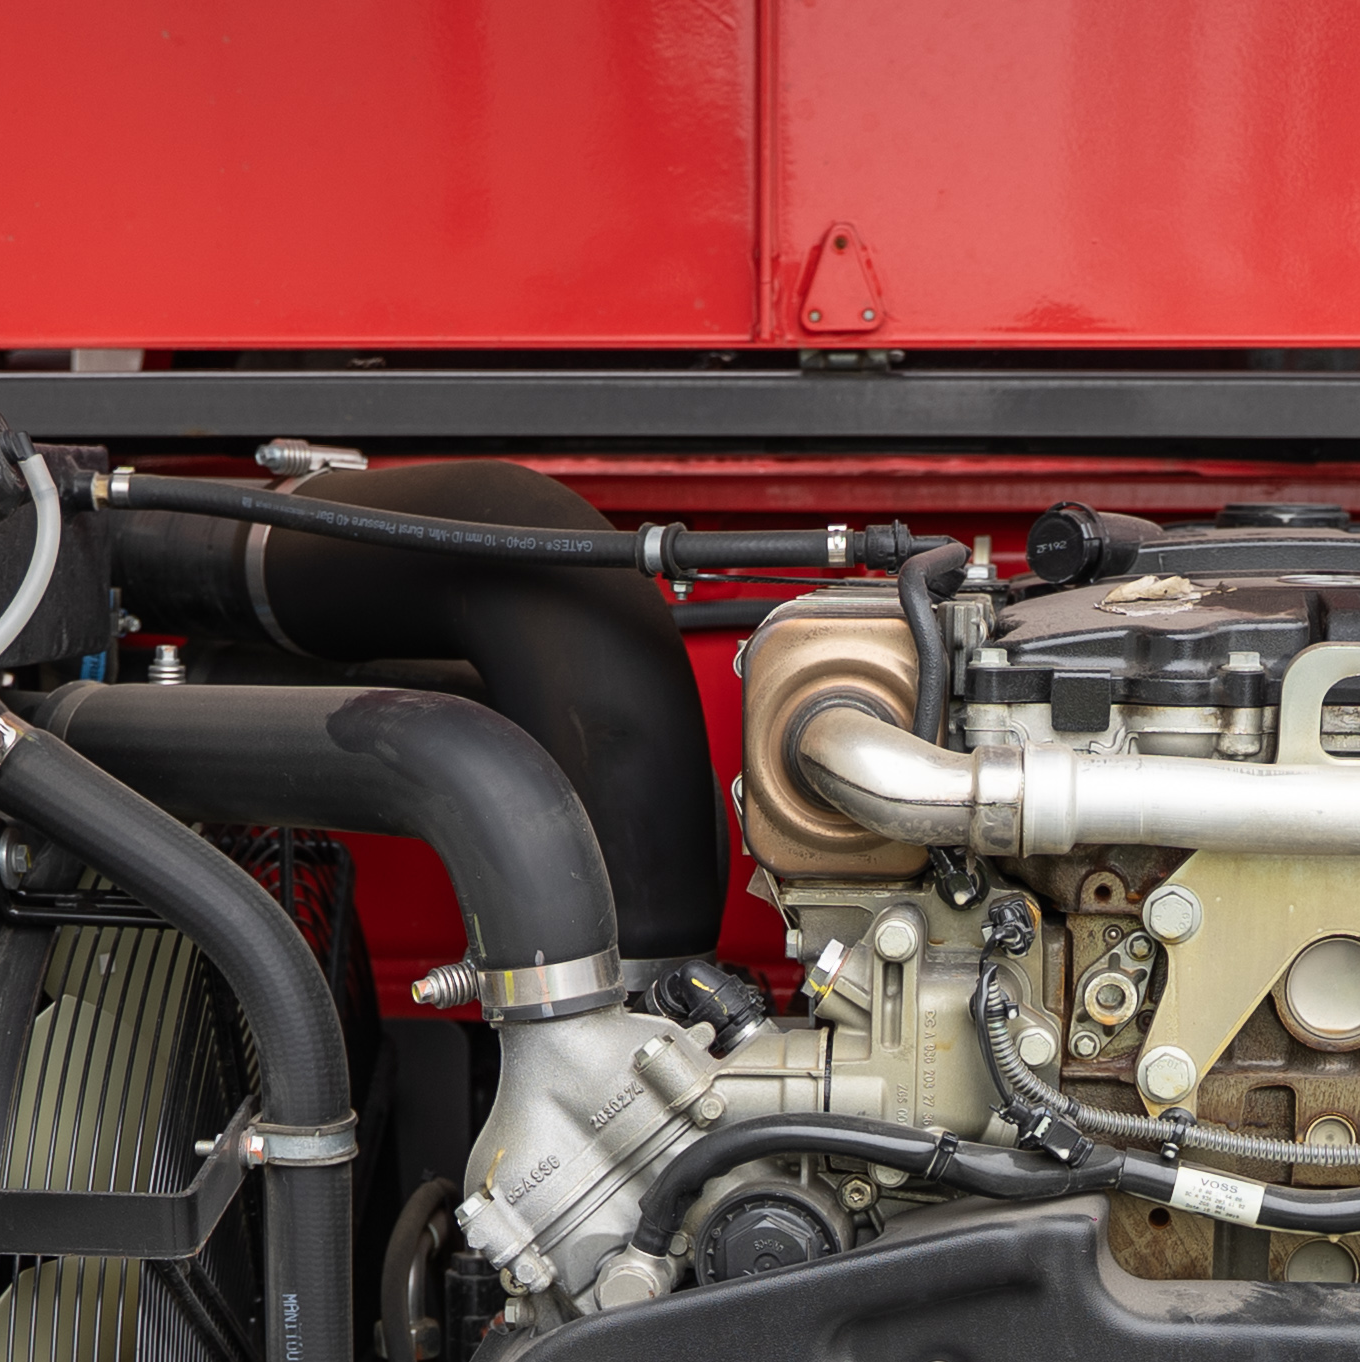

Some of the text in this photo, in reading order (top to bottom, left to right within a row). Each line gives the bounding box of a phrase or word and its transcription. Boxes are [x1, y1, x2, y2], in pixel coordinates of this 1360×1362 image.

[316, 510, 335, 526] Bar
[336, 514, 350, 528] 40
[352, 516, 396, 536] Pressure
[398, 524, 424, 539] Burst
[452, 531, 464, 544] ID
[465, 532, 483, 543] mm
[484, 534, 497, 547] 10
[507, 536, 536, 550] GP40
[1200, 1177, 1239, 1194] VOSS
[282, 1293, 304, 1361] MANITOU
